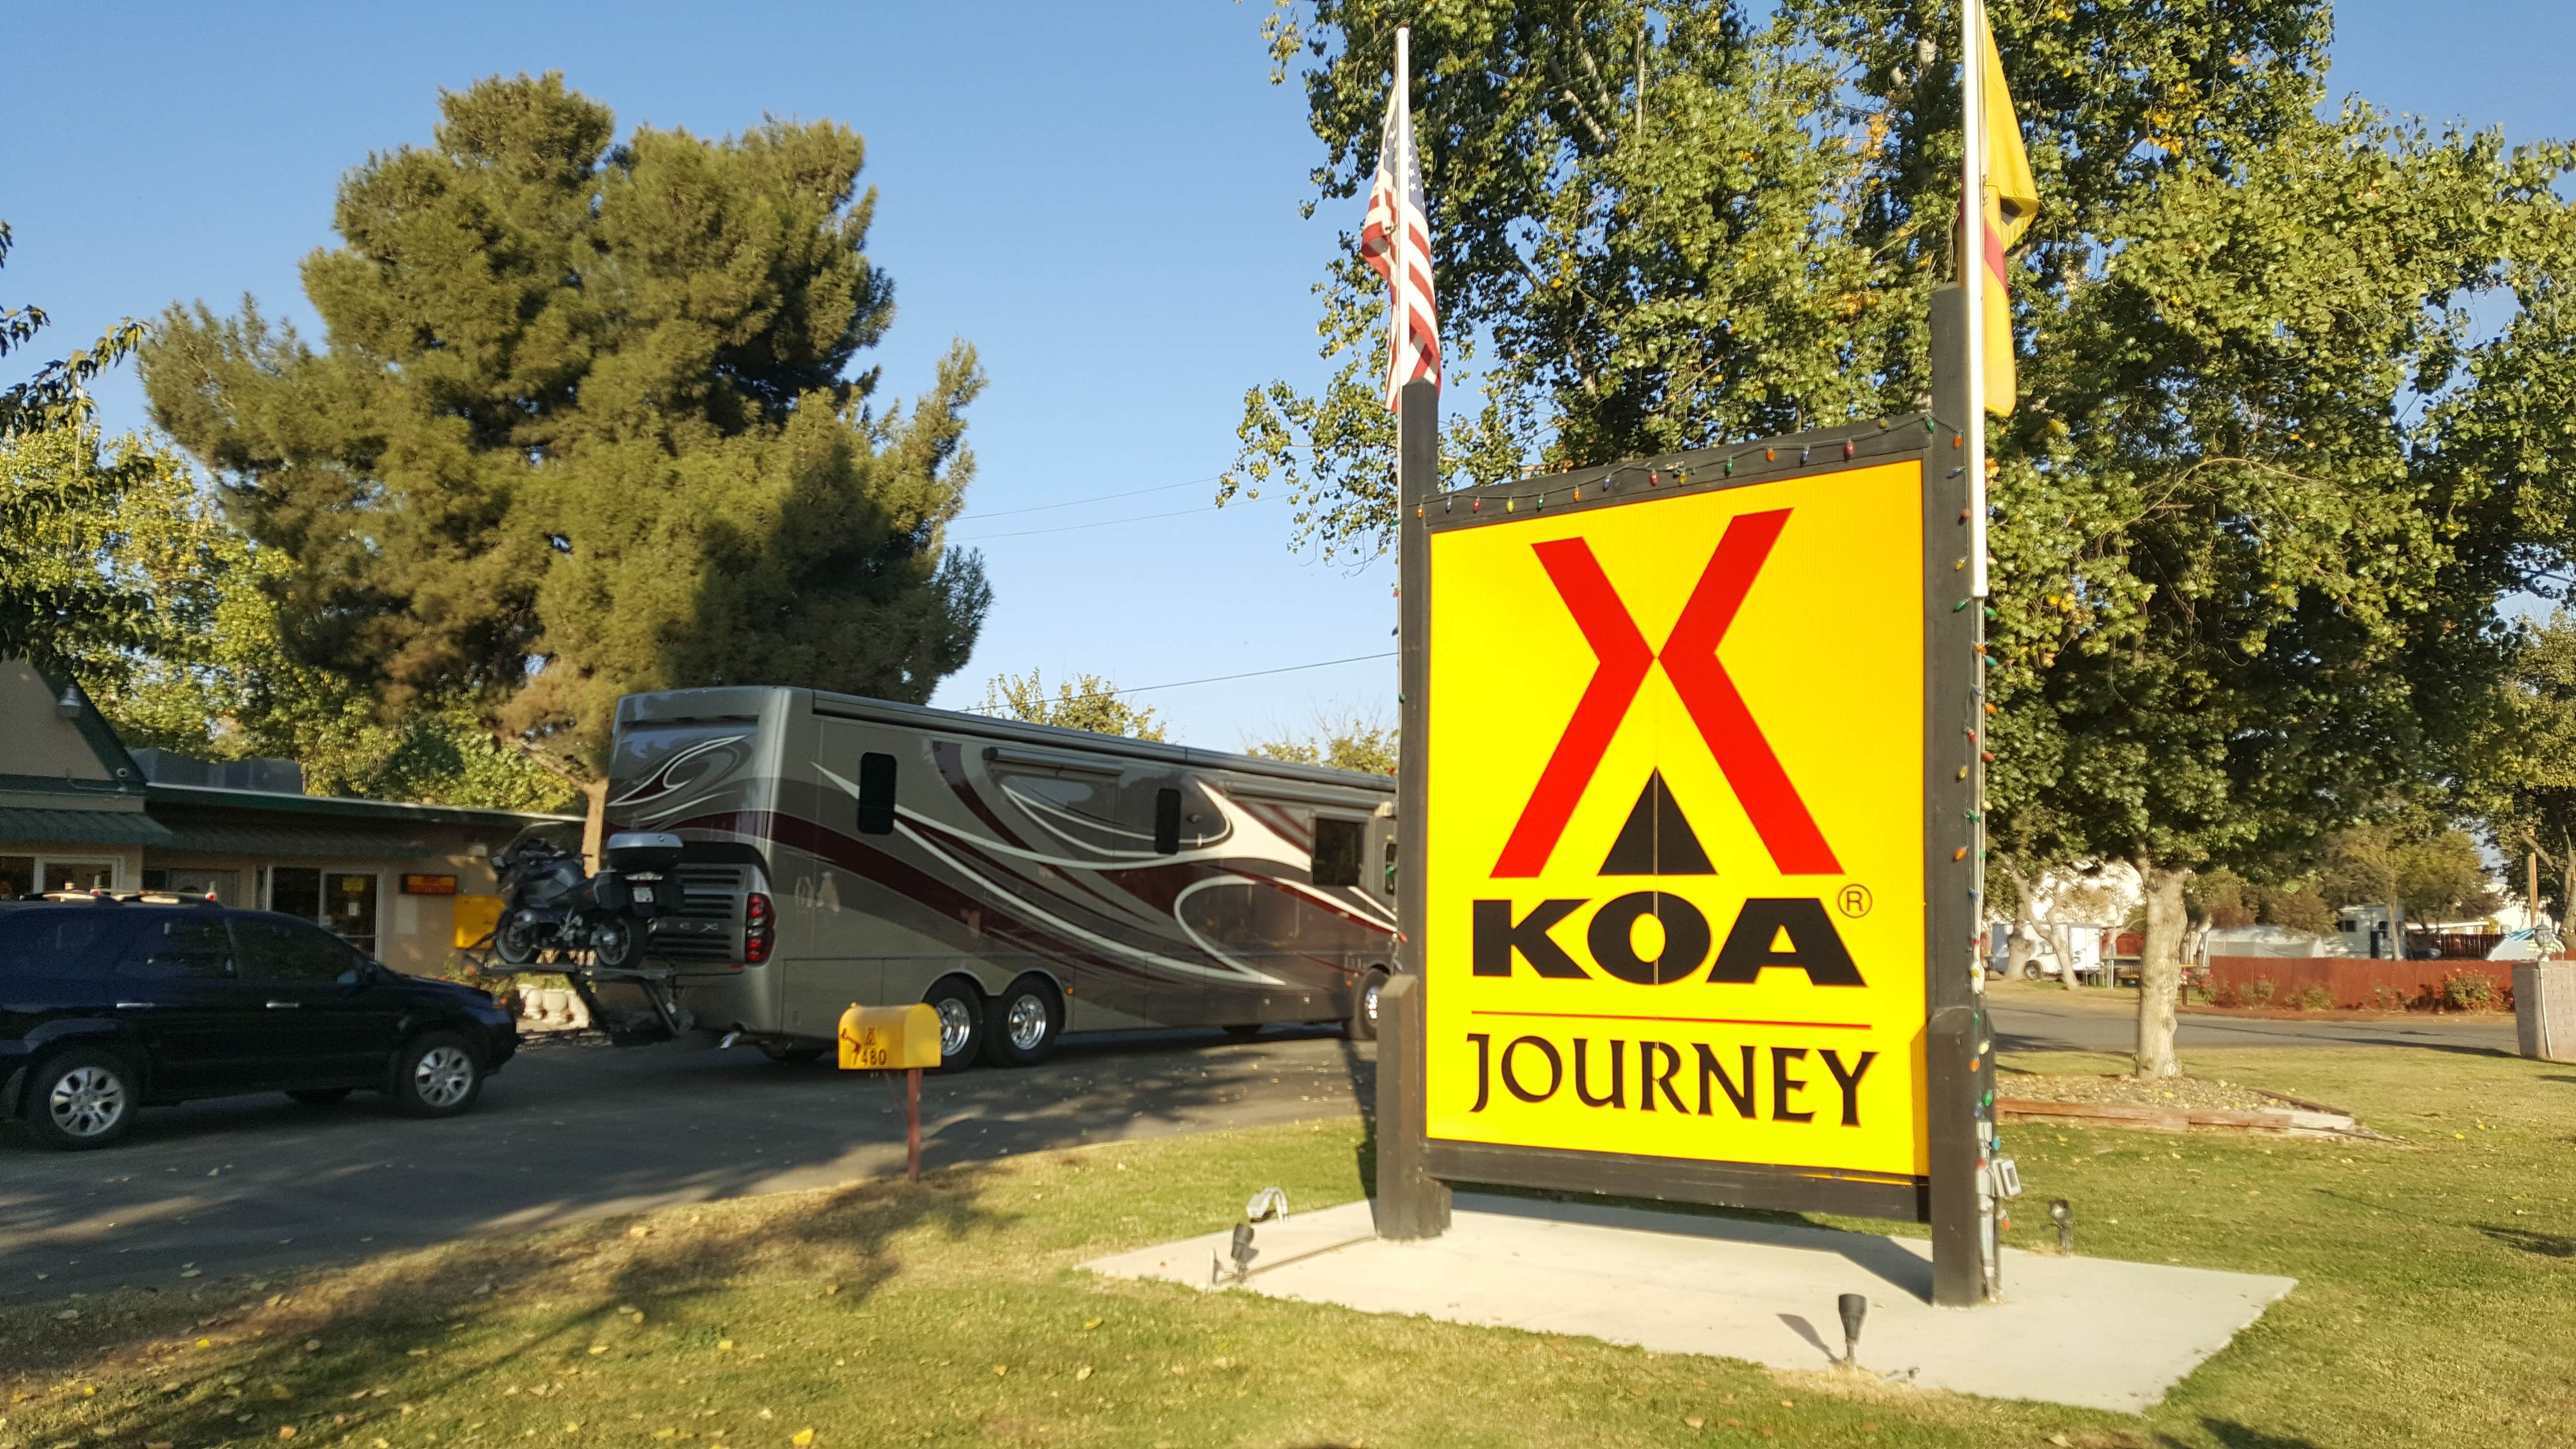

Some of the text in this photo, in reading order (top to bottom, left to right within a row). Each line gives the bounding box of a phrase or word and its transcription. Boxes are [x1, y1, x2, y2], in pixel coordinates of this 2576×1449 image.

[1473, 891, 1866, 986] KOA
[853, 1047, 887, 1066] 7480
[1466, 1032, 1880, 1127] JOURNEY
